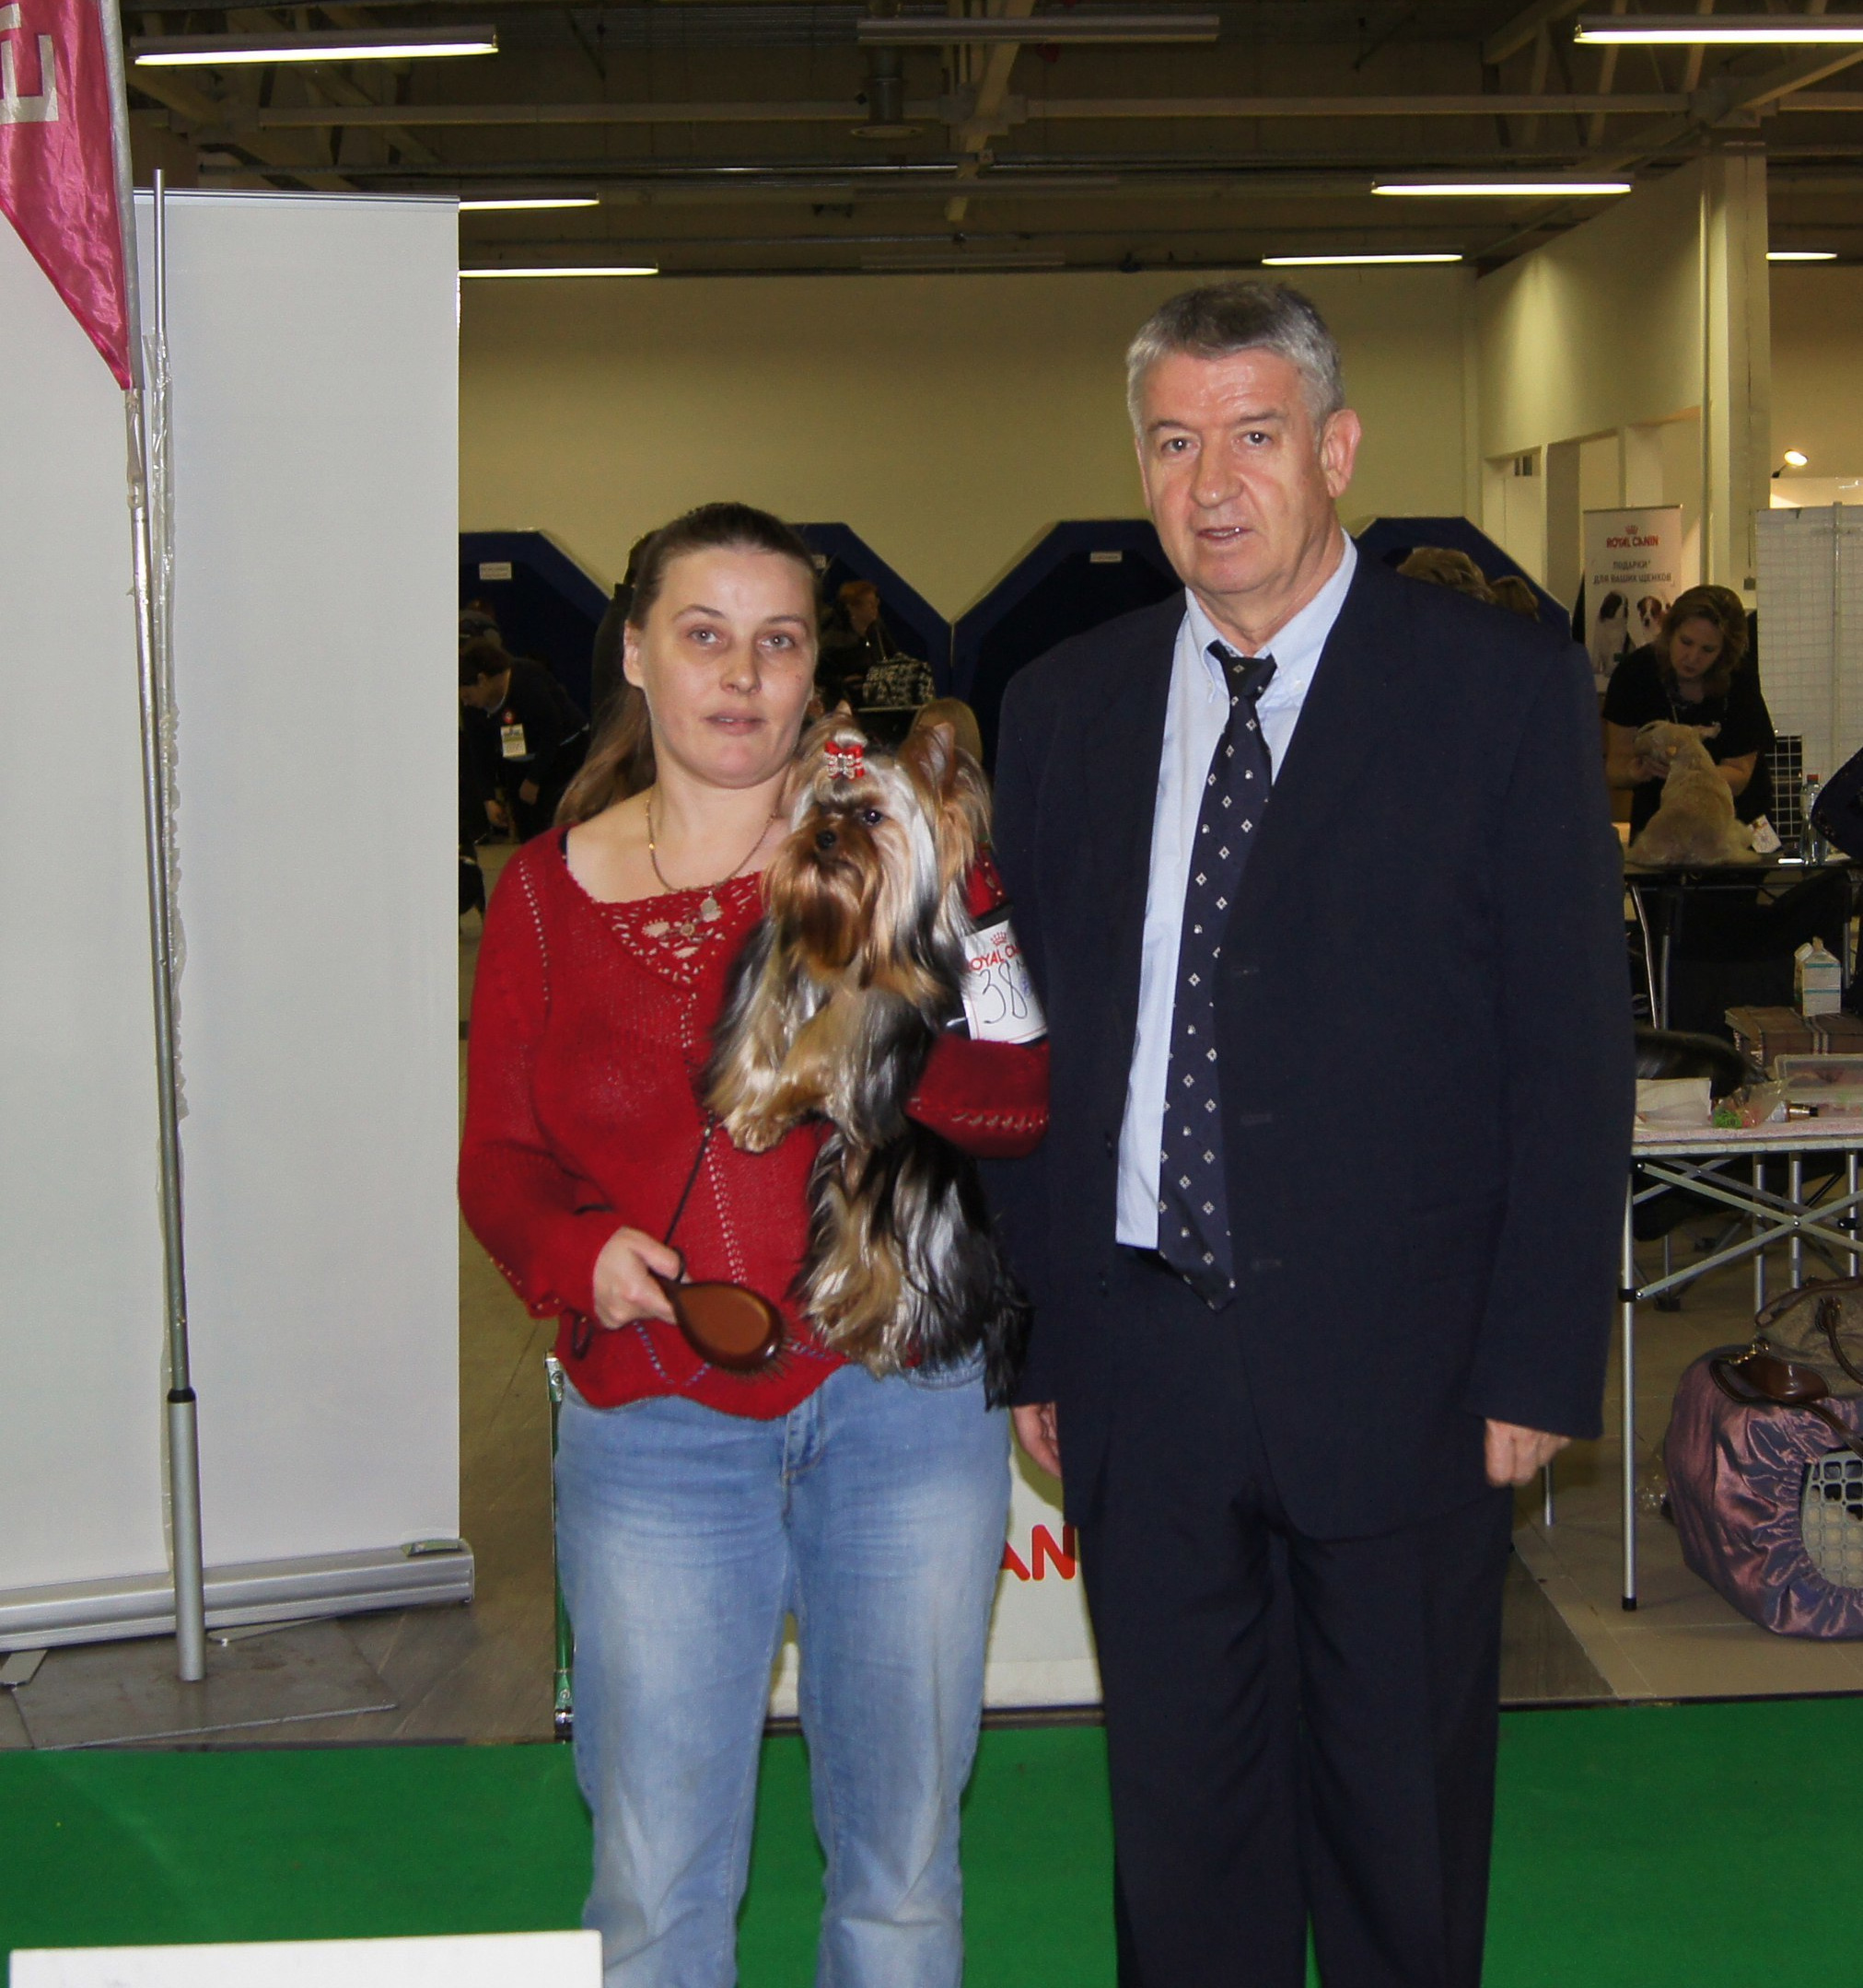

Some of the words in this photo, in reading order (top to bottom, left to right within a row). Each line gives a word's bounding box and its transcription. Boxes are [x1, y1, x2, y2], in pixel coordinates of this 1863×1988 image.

[1606, 537, 1631, 548] ROYAL
[1632, 535, 1659, 547] CANIN
[1593, 575, 1609, 584] ДЛЯ
[1611, 574, 1636, 583] ВАШИХ
[1638, 573, 1672, 583] ЩЕНКОВ
[968, 949, 1004, 971] OYAL
[979, 960, 1028, 1024] 38
